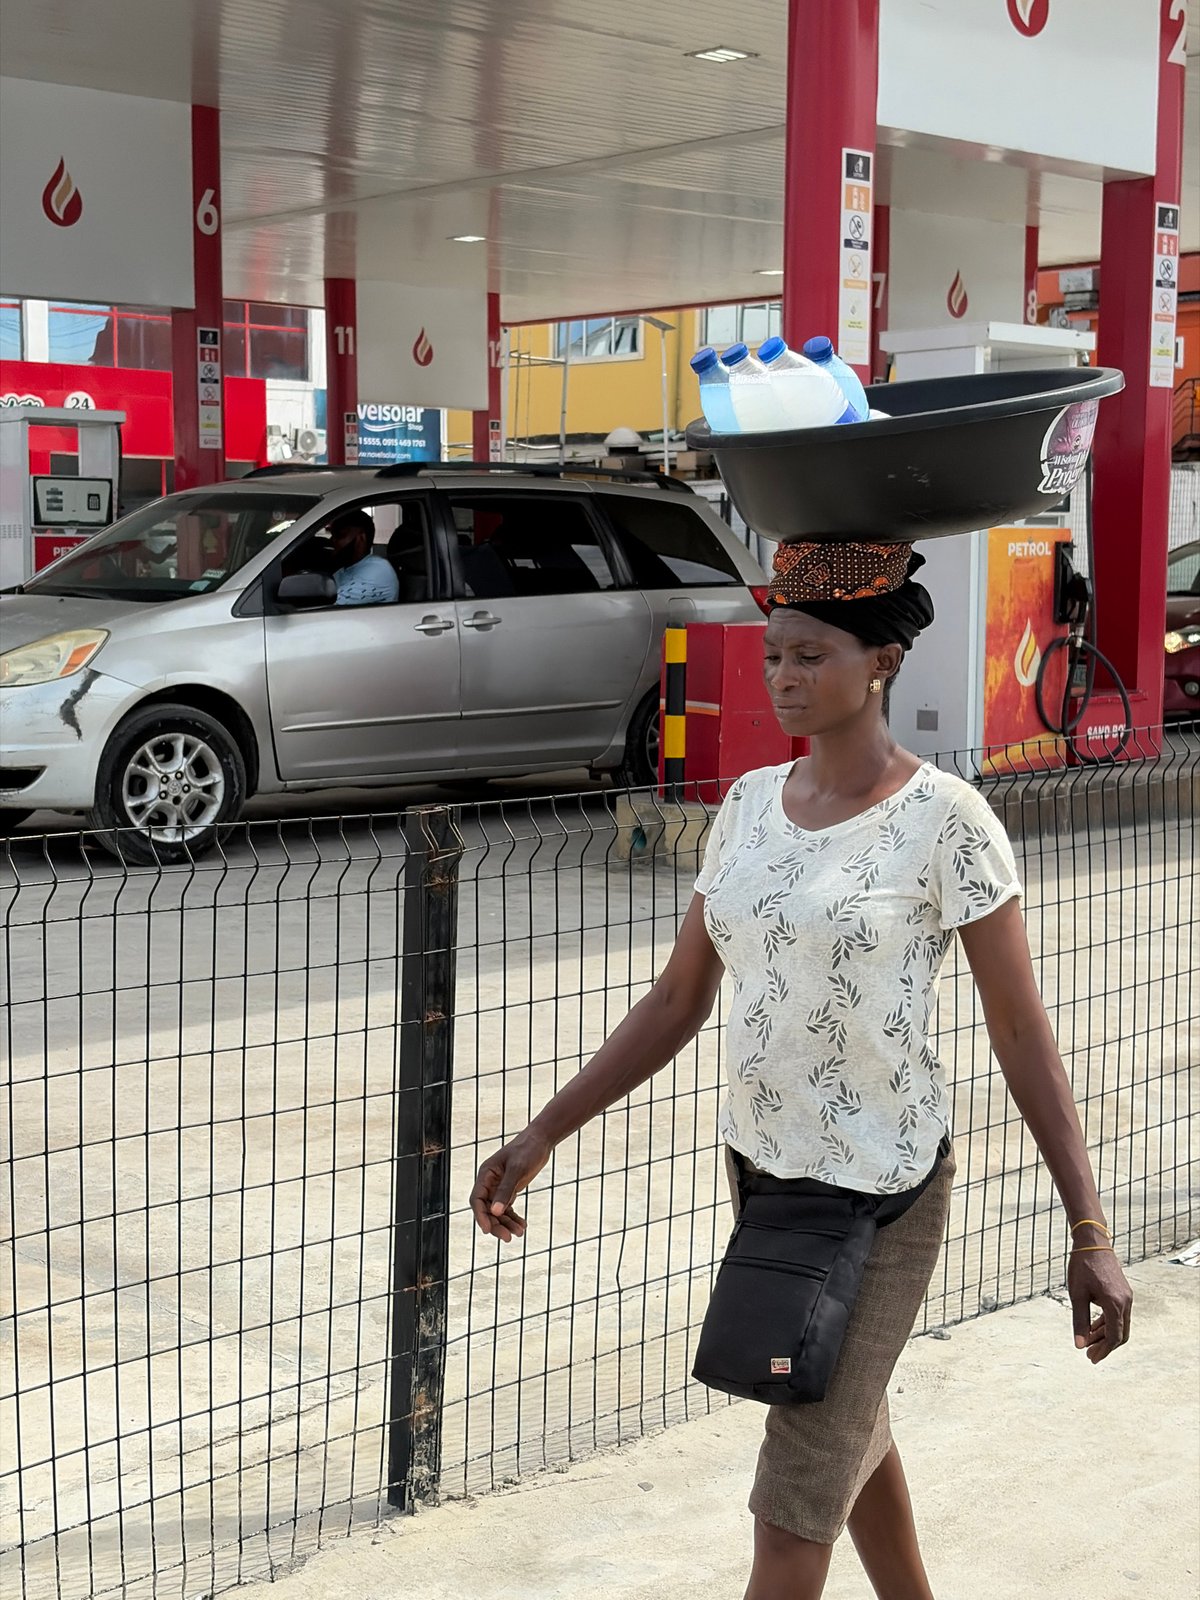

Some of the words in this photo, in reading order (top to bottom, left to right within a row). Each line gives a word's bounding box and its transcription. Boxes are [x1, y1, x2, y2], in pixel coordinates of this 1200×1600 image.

[1166, 0, 1187, 66] 2
[196, 188, 218, 235] 6
[872, 272, 887, 309] 7
[1026, 289, 1038, 324] 8
[334, 326, 354, 355] 11
[1007, 541, 1052, 557] PETROL
[1087, 724, 1110, 740] SAND
[1112, 723, 1126, 739] BO
